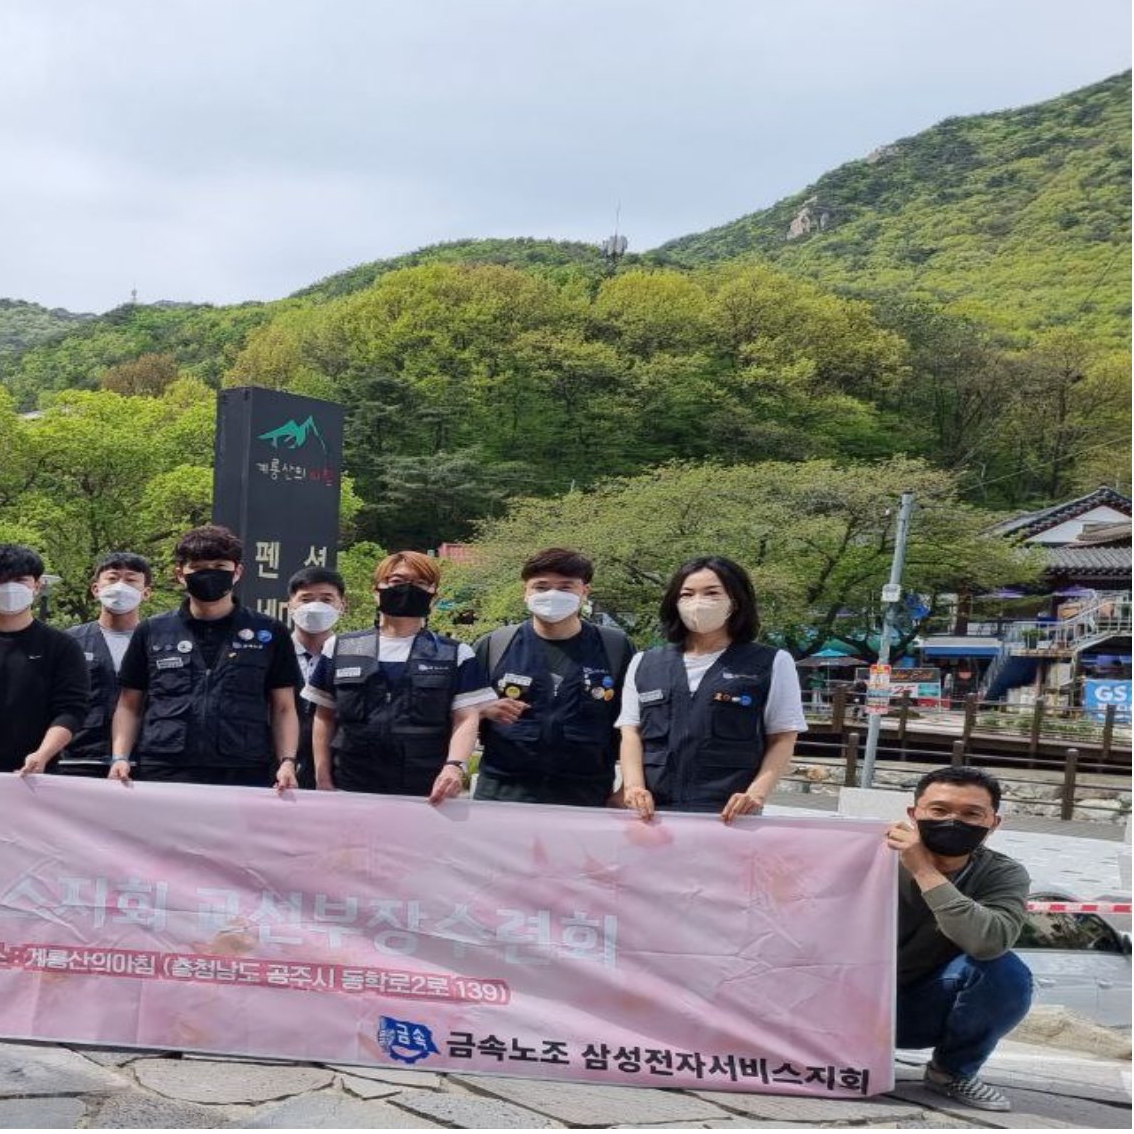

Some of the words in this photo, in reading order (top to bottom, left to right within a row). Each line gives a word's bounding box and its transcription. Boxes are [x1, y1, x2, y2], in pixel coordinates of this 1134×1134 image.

[25, 947, 156, 975] 계룡산의아침
[163, 957, 261, 983] (충청남도
[266, 966, 335, 989] 공주시
[455, 979, 507, 1003] 139)
[445, 1030, 571, 1064] 금속노조
[580, 1046, 870, 1095] 삼성전자서비스지회
